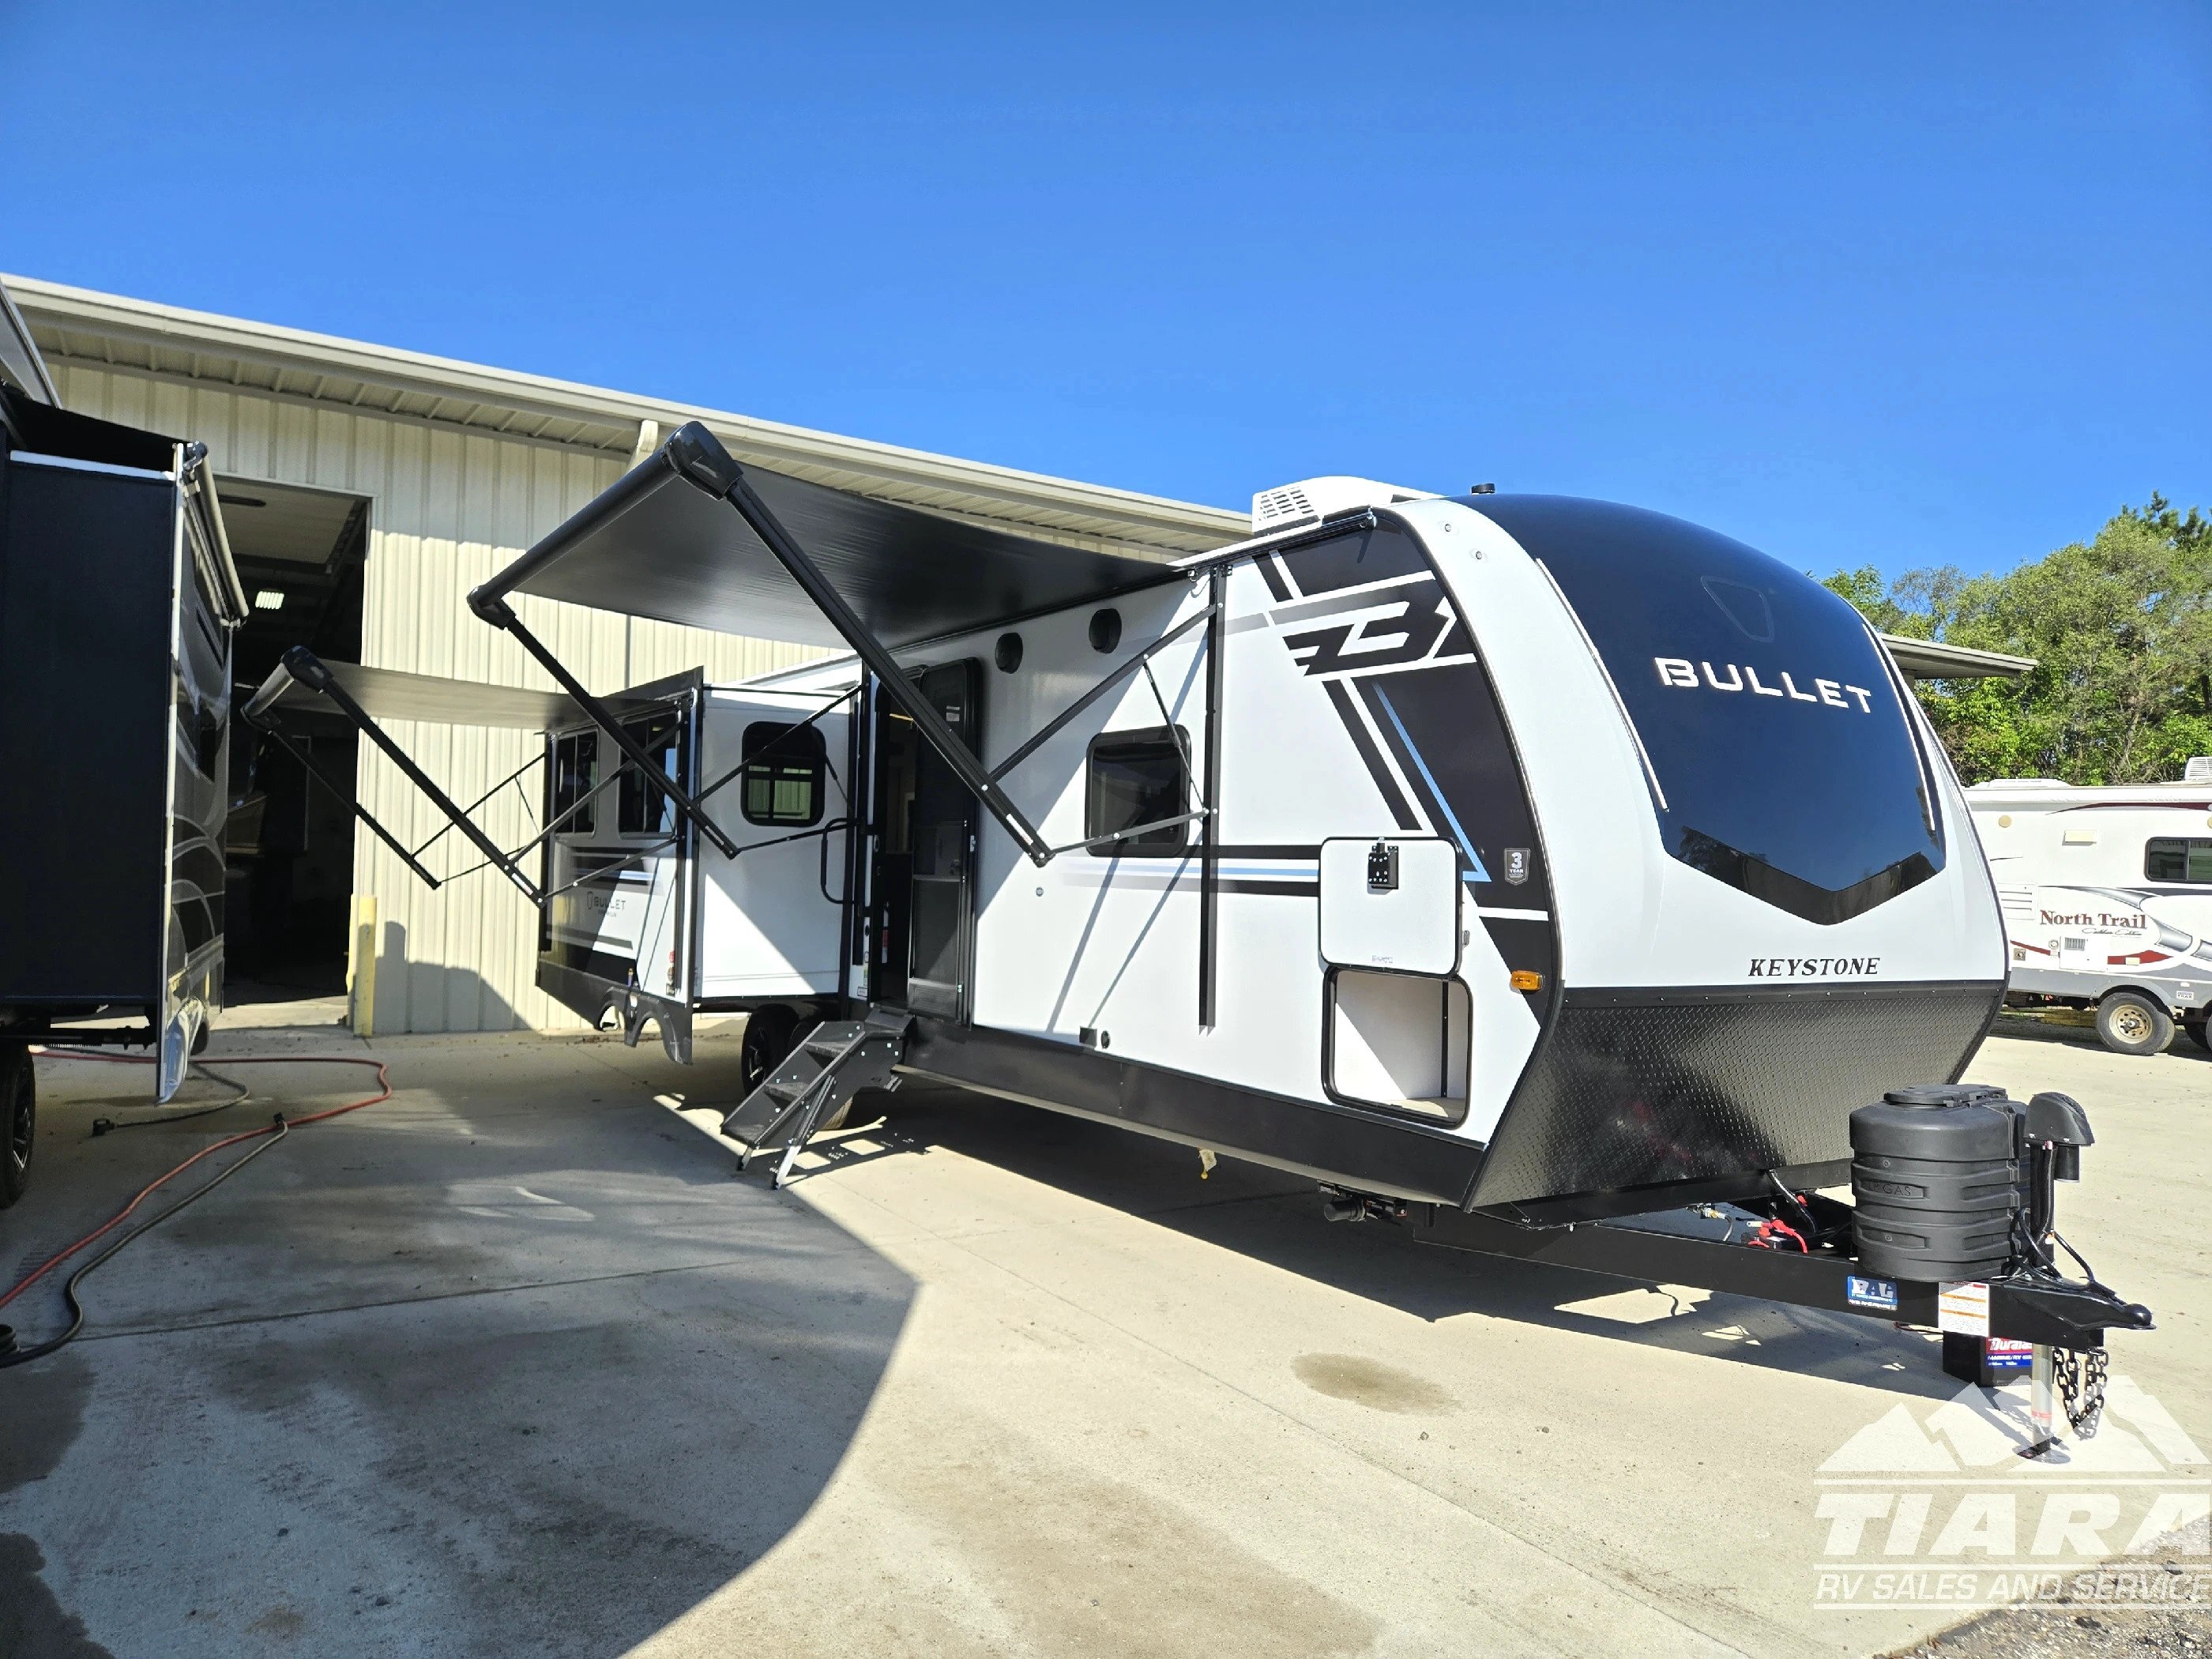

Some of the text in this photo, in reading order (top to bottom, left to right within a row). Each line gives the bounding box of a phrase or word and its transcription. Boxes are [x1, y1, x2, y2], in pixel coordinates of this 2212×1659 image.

[1654, 657, 1872, 713] BULLET
[1511, 852, 1522, 869] 3
[593, 896, 626, 910] BULLET
[2040, 909, 2147, 929] North Trail
[1748, 957, 1880, 976] KEYSTONE
[1883, 1183, 1911, 1196] GAS
[1852, 1279, 1894, 1298] BAL
[1988, 1337, 2033, 1350] Duralas
